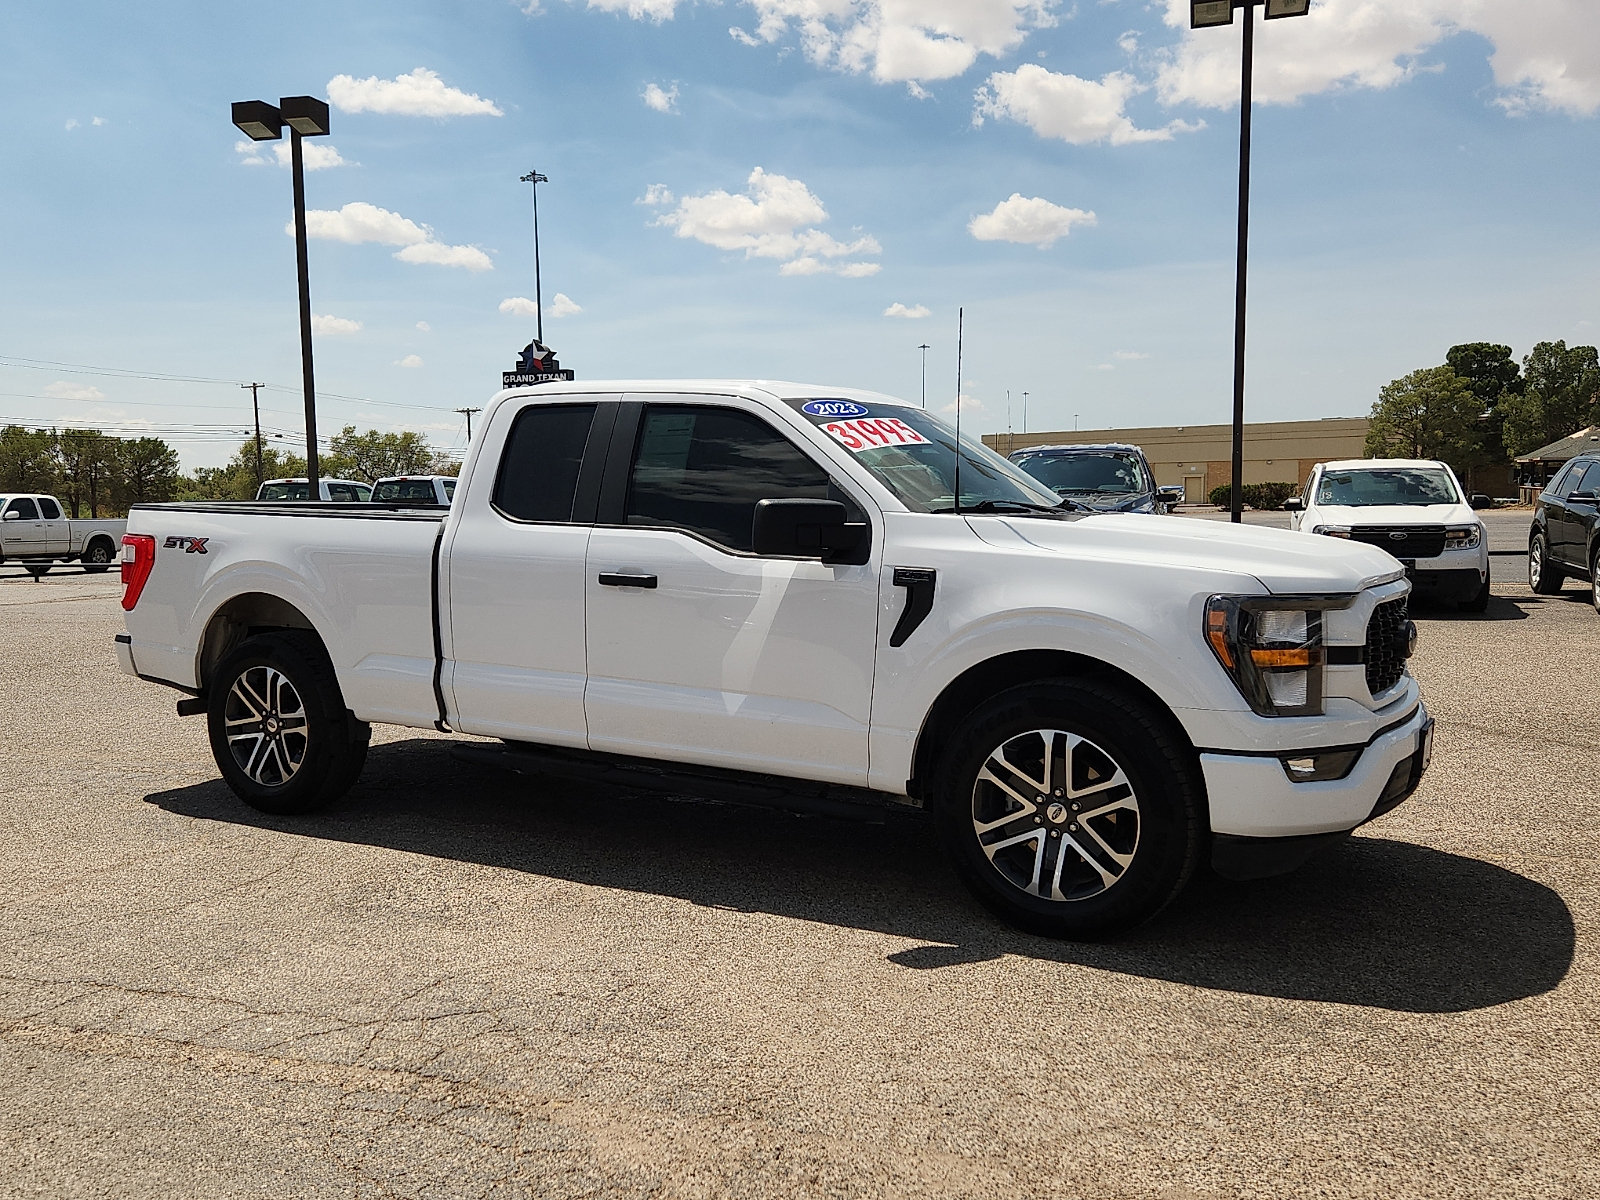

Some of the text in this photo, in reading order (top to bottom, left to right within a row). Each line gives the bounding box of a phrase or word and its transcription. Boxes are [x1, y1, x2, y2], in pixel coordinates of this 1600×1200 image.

[503, 372, 567, 383] GRAND TEXAN
[814, 403, 859, 415] 2023
[827, 419, 922, 449] 31995
[163, 536, 209, 554] STX
